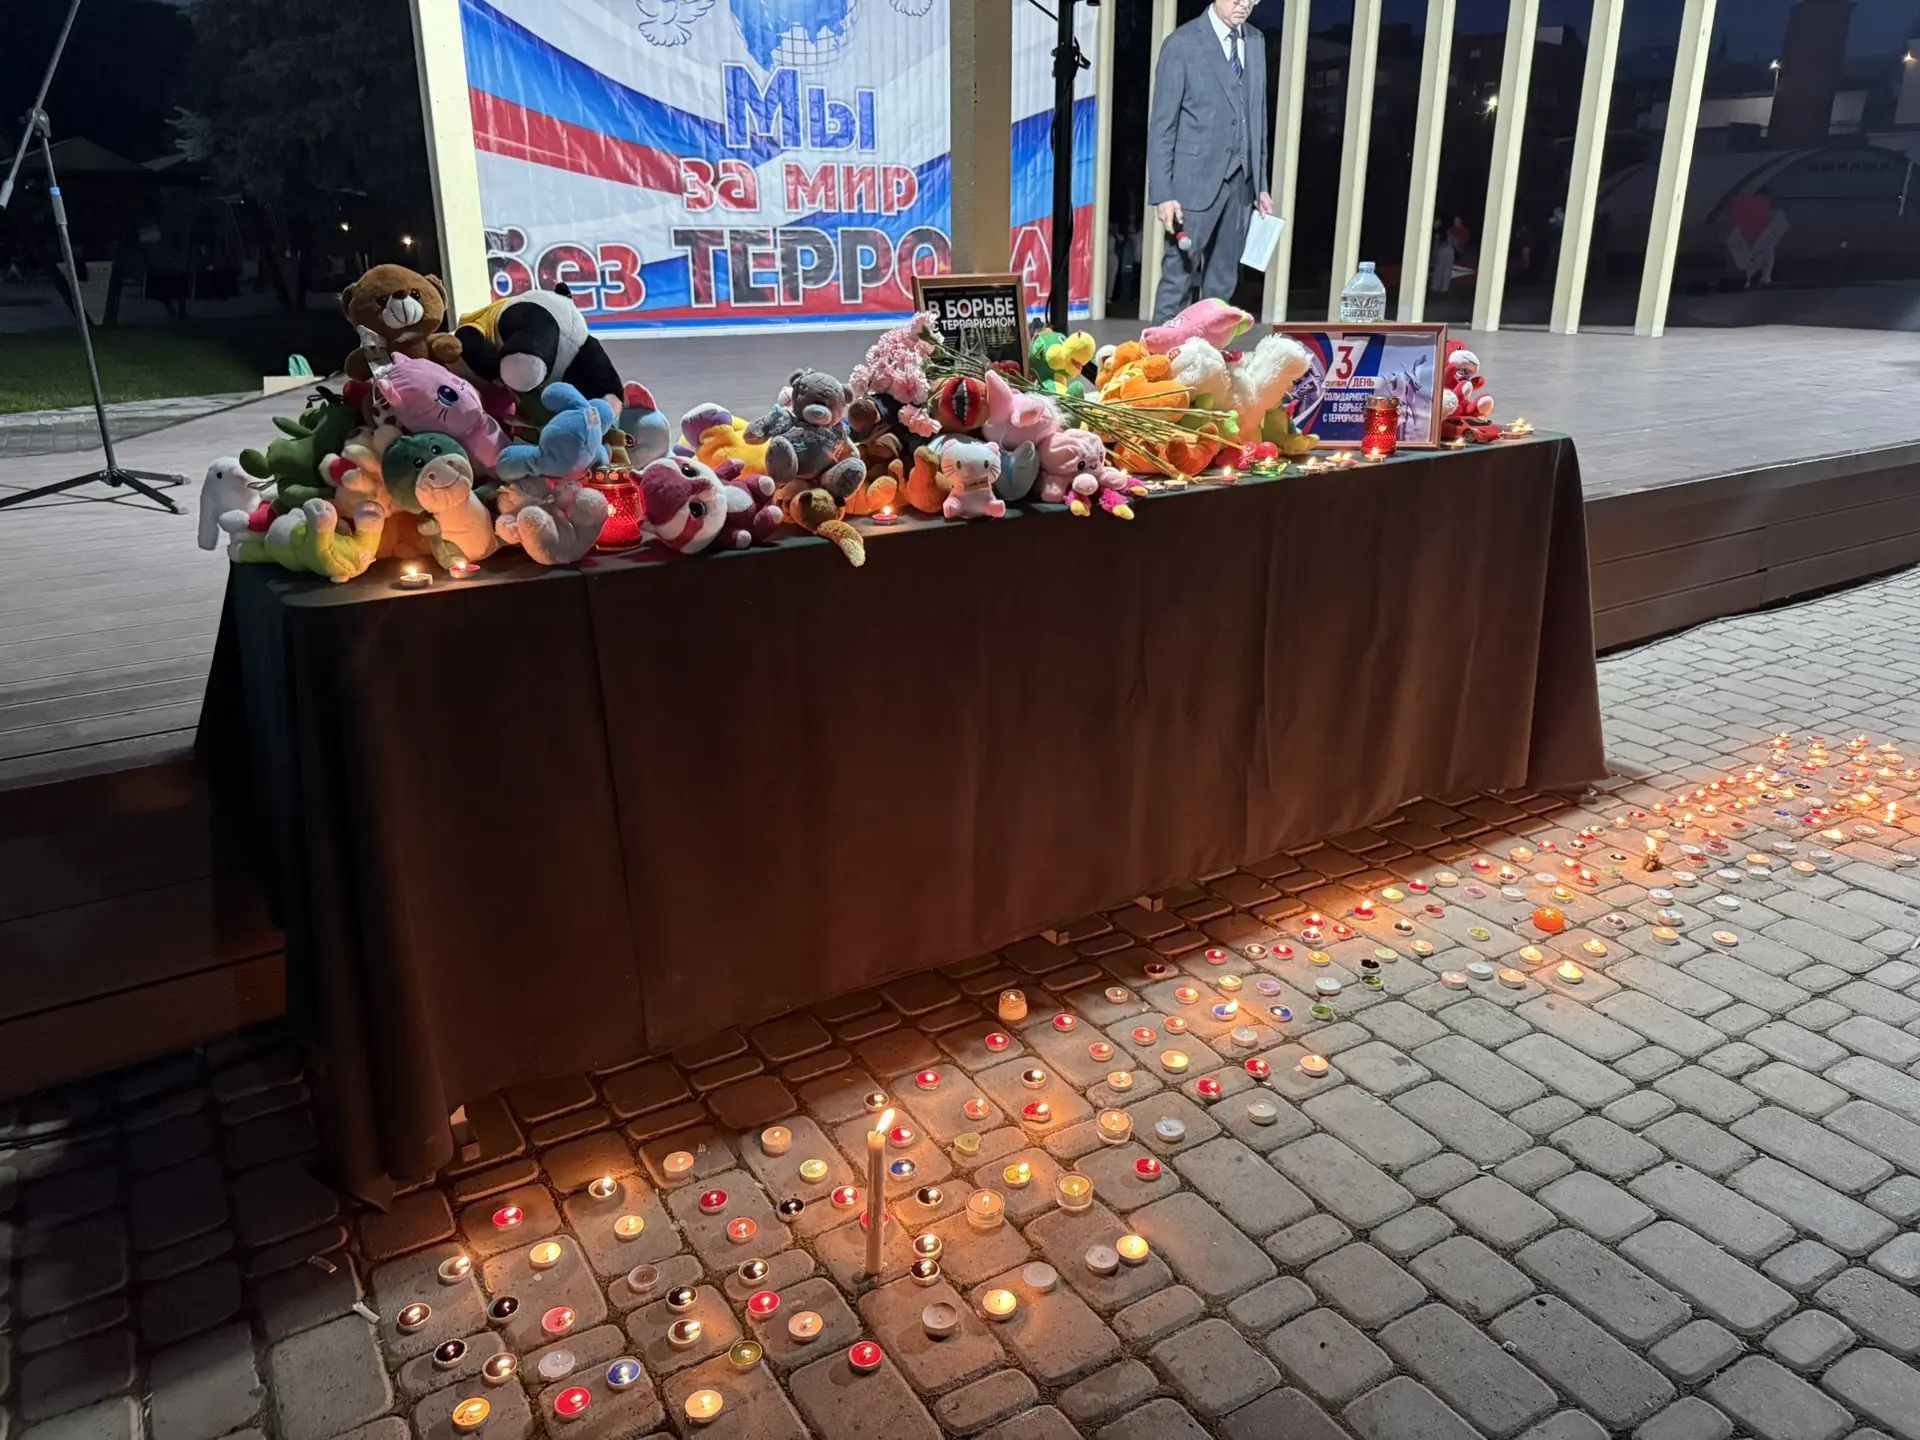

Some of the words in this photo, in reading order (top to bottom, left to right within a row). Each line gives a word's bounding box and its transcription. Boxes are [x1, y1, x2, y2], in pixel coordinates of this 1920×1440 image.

[722, 63, 878, 153] Мы
[680, 158, 760, 212] за
[783, 162, 919, 216] мир
[484, 226, 646, 311] без
[671, 225, 1052, 307] ТЕРРОА
[928, 300, 941, 319] В
[945, 297, 1016, 319] БОРЬБЕ
[941, 316, 1017, 331] ТЕРРОРИЗМОМ
[1335, 345, 1354, 380] 3
[1352, 377, 1375, 388] ДЕНЬ
[1322, 413, 1328, 423] С
[1332, 403, 1338, 413] В
[1338, 403, 1364, 413] БОРЬБЕ
